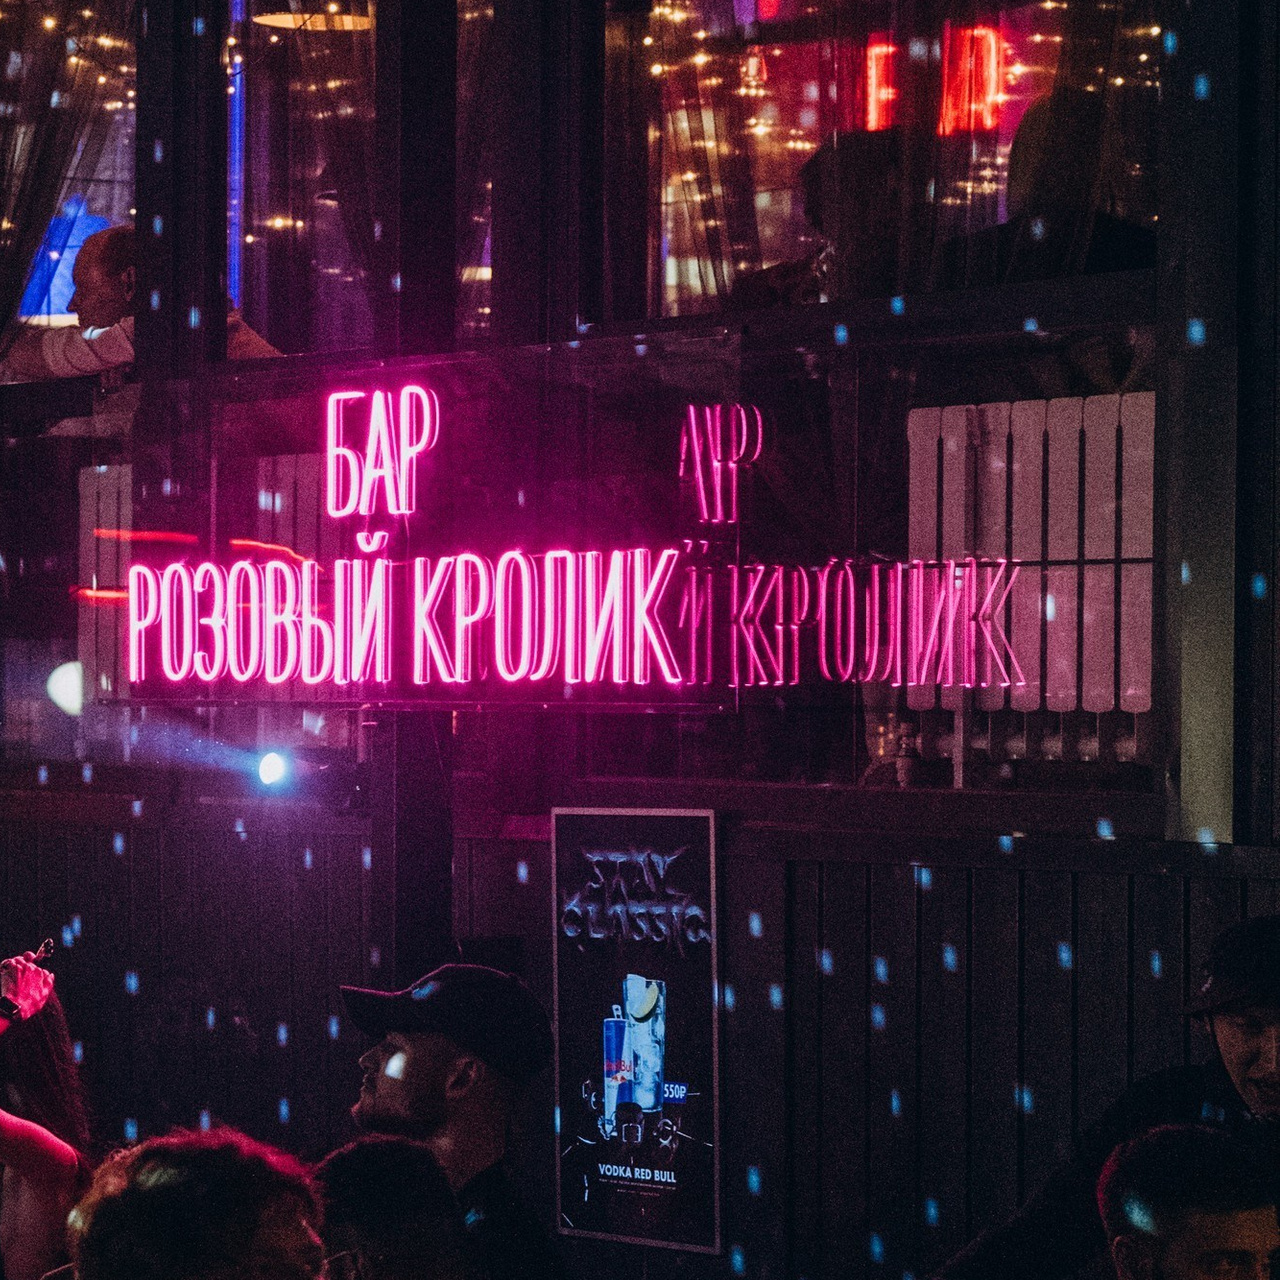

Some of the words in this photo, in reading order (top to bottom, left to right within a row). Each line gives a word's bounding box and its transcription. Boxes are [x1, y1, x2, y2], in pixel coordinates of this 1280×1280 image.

[326, 384, 439, 518] БАР
[127, 530, 392, 684] РОЗОВЫЙ
[416, 548, 682, 685] КРОЛИК
[598, 1163, 632, 1178] VODKA
[634, 1167, 652, 1180] RED
[654, 1170, 677, 1183] BULL
